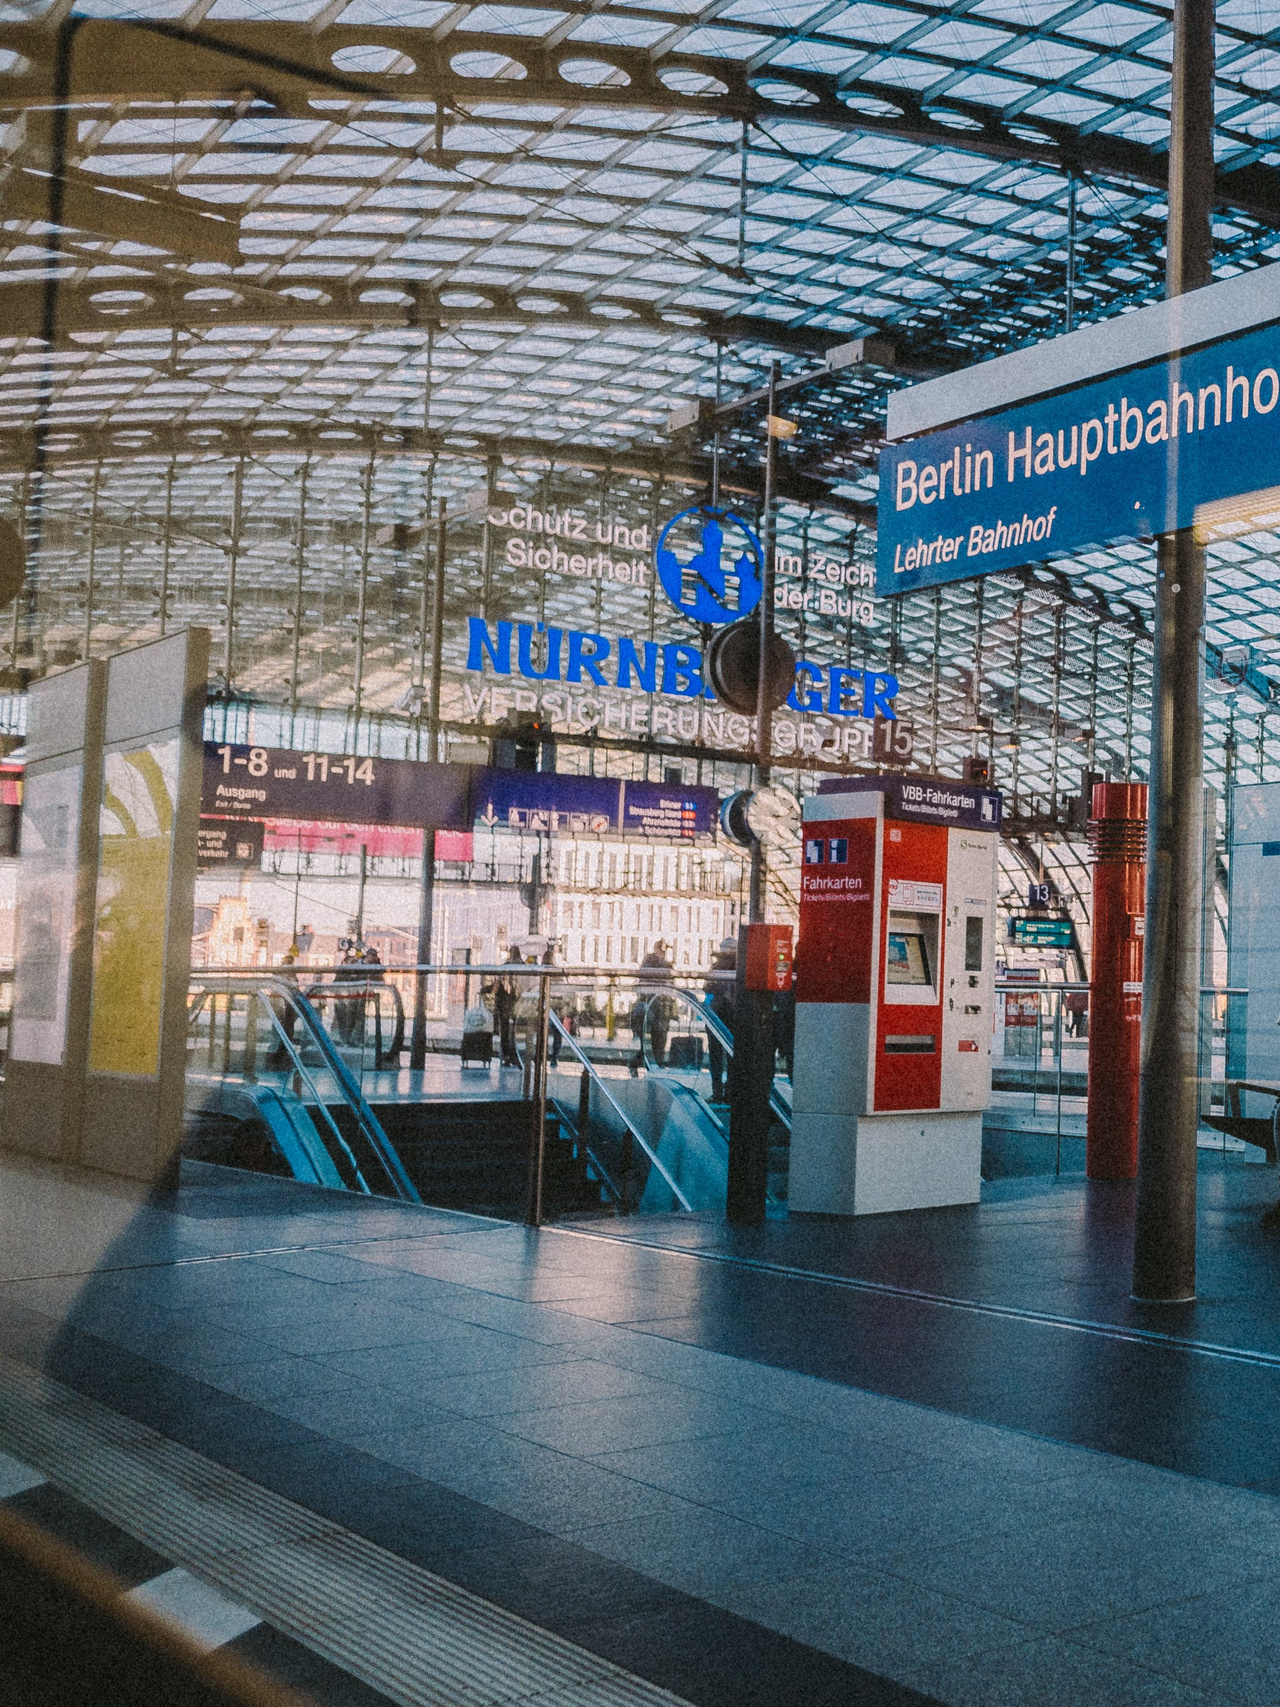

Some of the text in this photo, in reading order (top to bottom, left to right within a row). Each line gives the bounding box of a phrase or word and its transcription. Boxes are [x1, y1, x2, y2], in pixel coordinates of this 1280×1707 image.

[896, 443, 994, 511] Berlin
[596, 519, 649, 551] und
[893, 505, 1058, 574] Lehrter Bahnhof
[505, 537, 649, 587] Sicherheit
[807, 554, 876, 588] Zeich
[774, 584, 875, 627] der Burg
[467, 616, 900, 720] NÜRNBGER
[879, 718, 913, 755] 15
[217, 745, 375, 786] 1-8 und 11-14
[216, 784, 267, 802] Ausgang
[902, 785, 975, 809] VBB-Fahrkarten
[803, 876, 862, 890] Fahrkarten
[1034, 884, 1049, 901] 13
